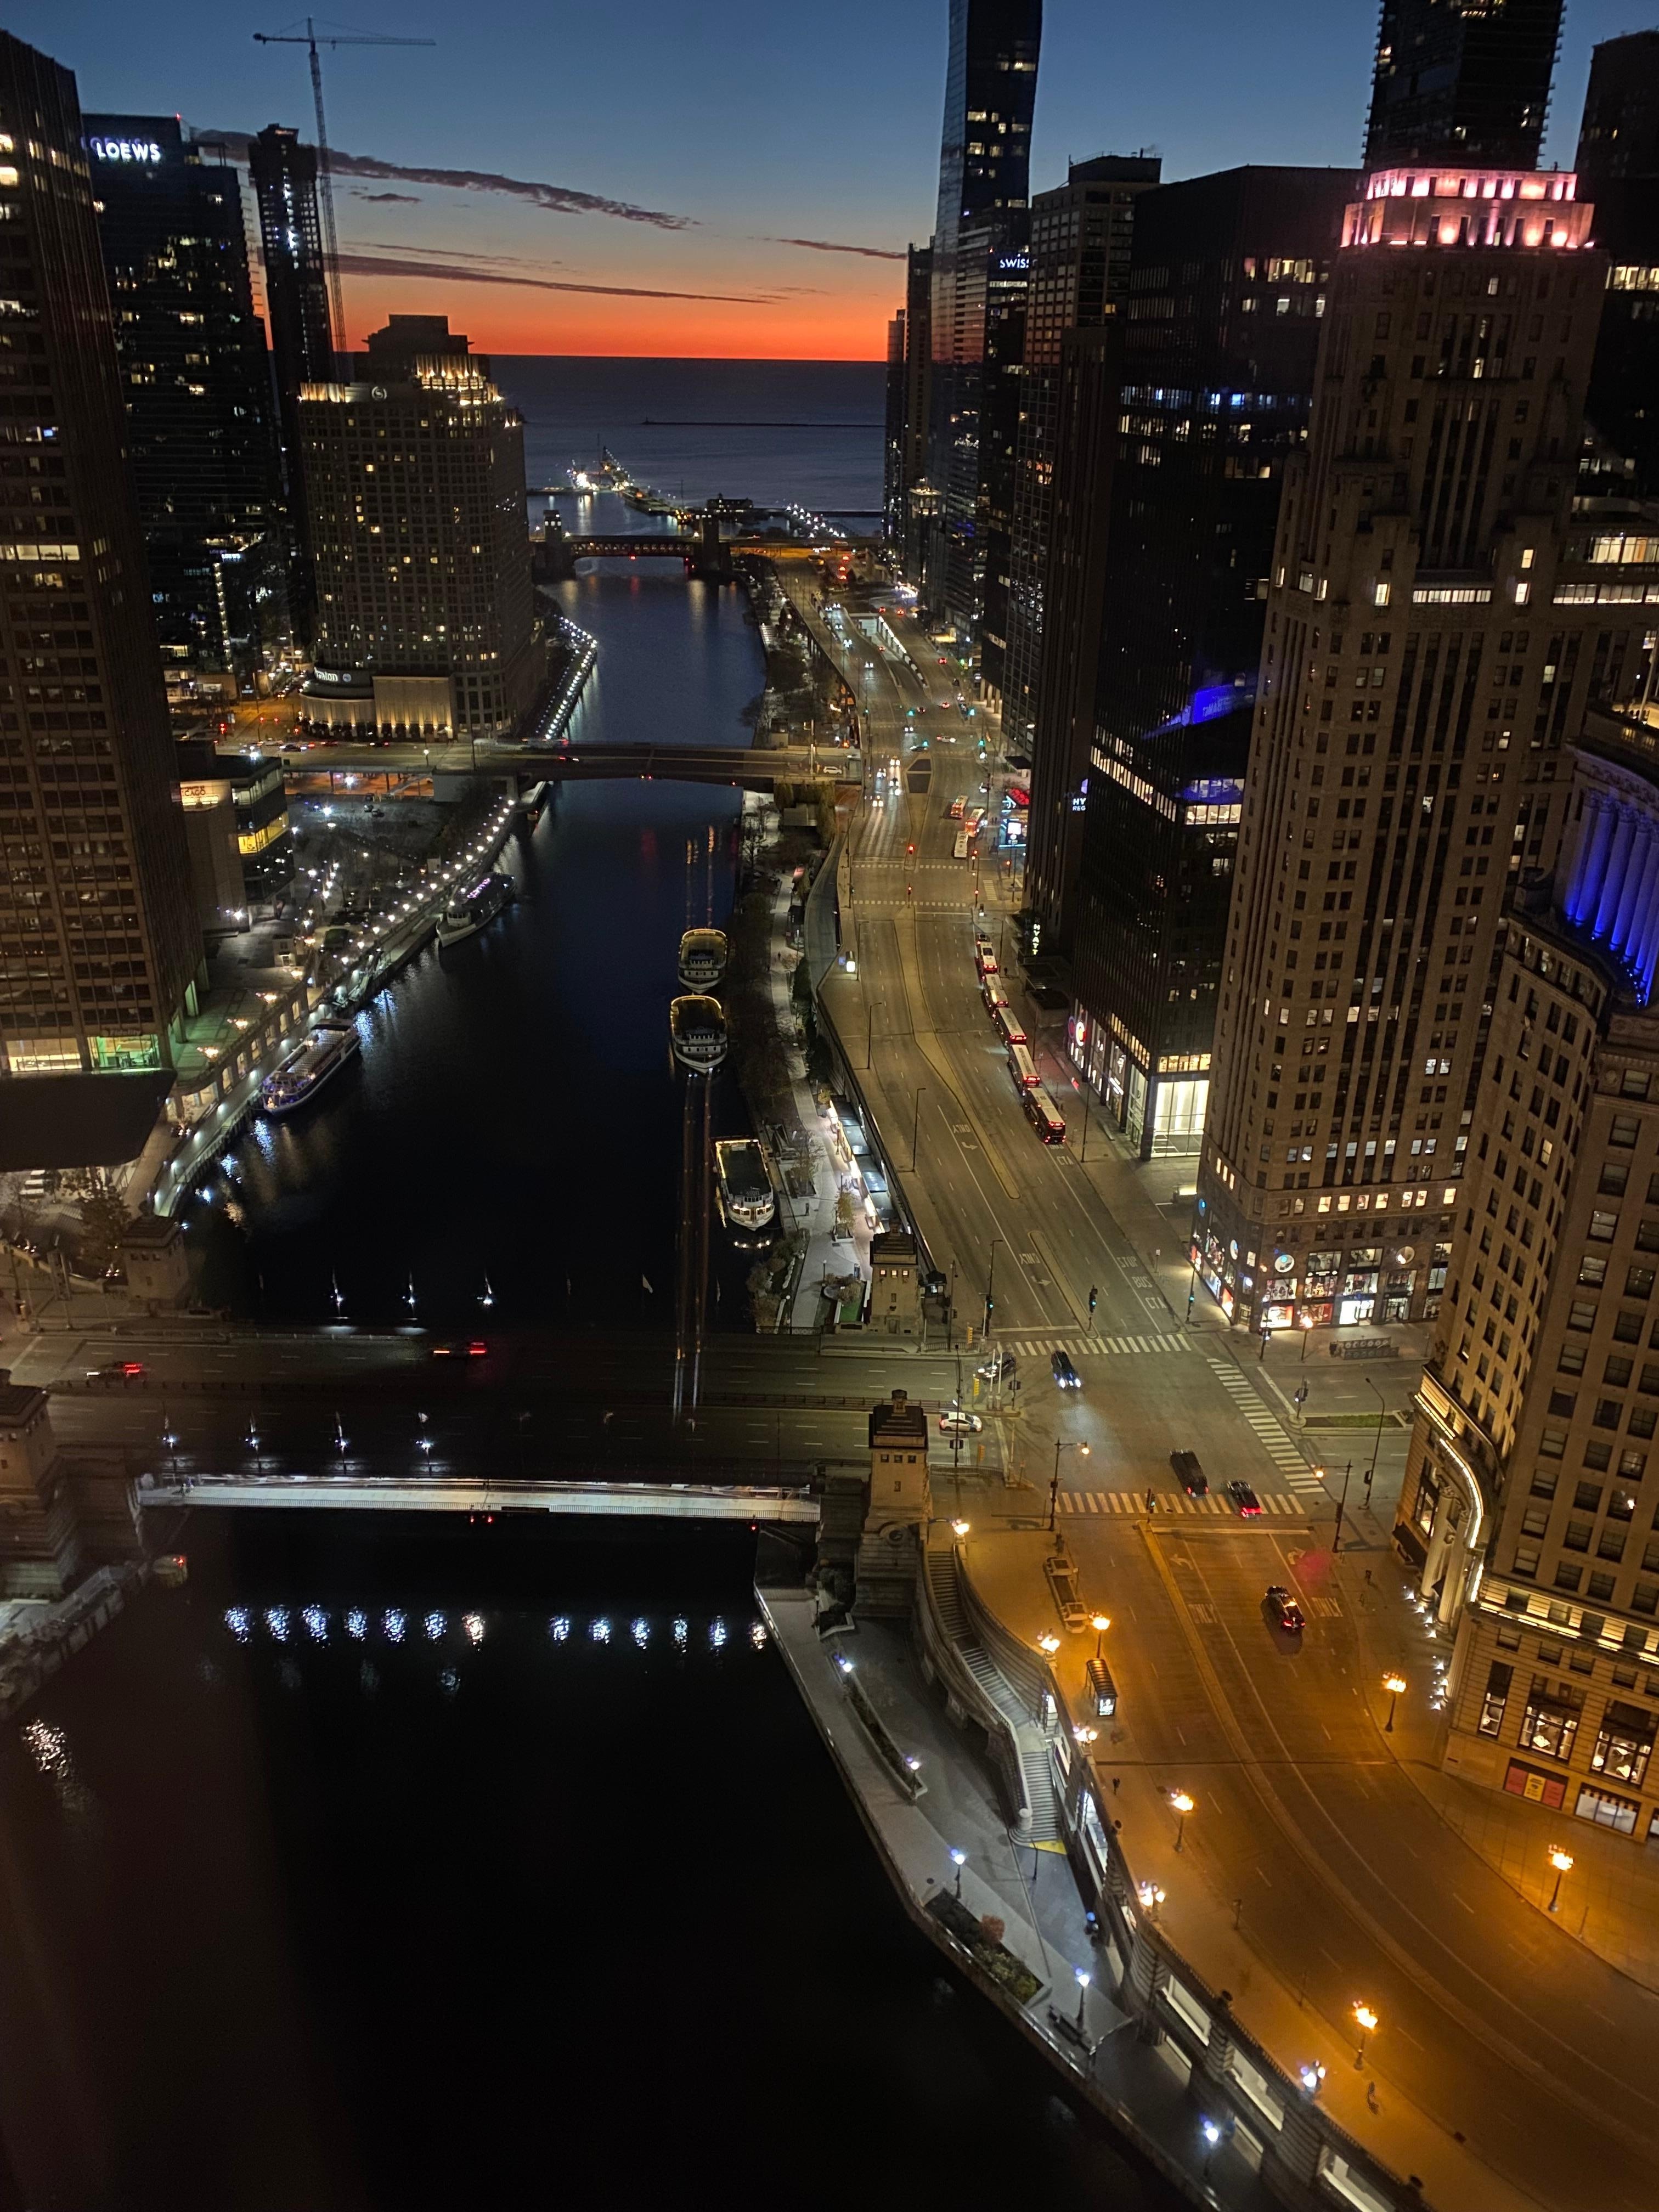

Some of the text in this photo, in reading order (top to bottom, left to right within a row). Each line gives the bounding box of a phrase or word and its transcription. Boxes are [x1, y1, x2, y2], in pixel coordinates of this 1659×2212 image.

[96, 142, 160, 163] LOEWS
[1032, 923, 1041, 955] HYATT
[1117, 1256, 1138, 1268] STOP
[1132, 1276, 1153, 1288] BUS
[1145, 1297, 1167, 1309] CTA
